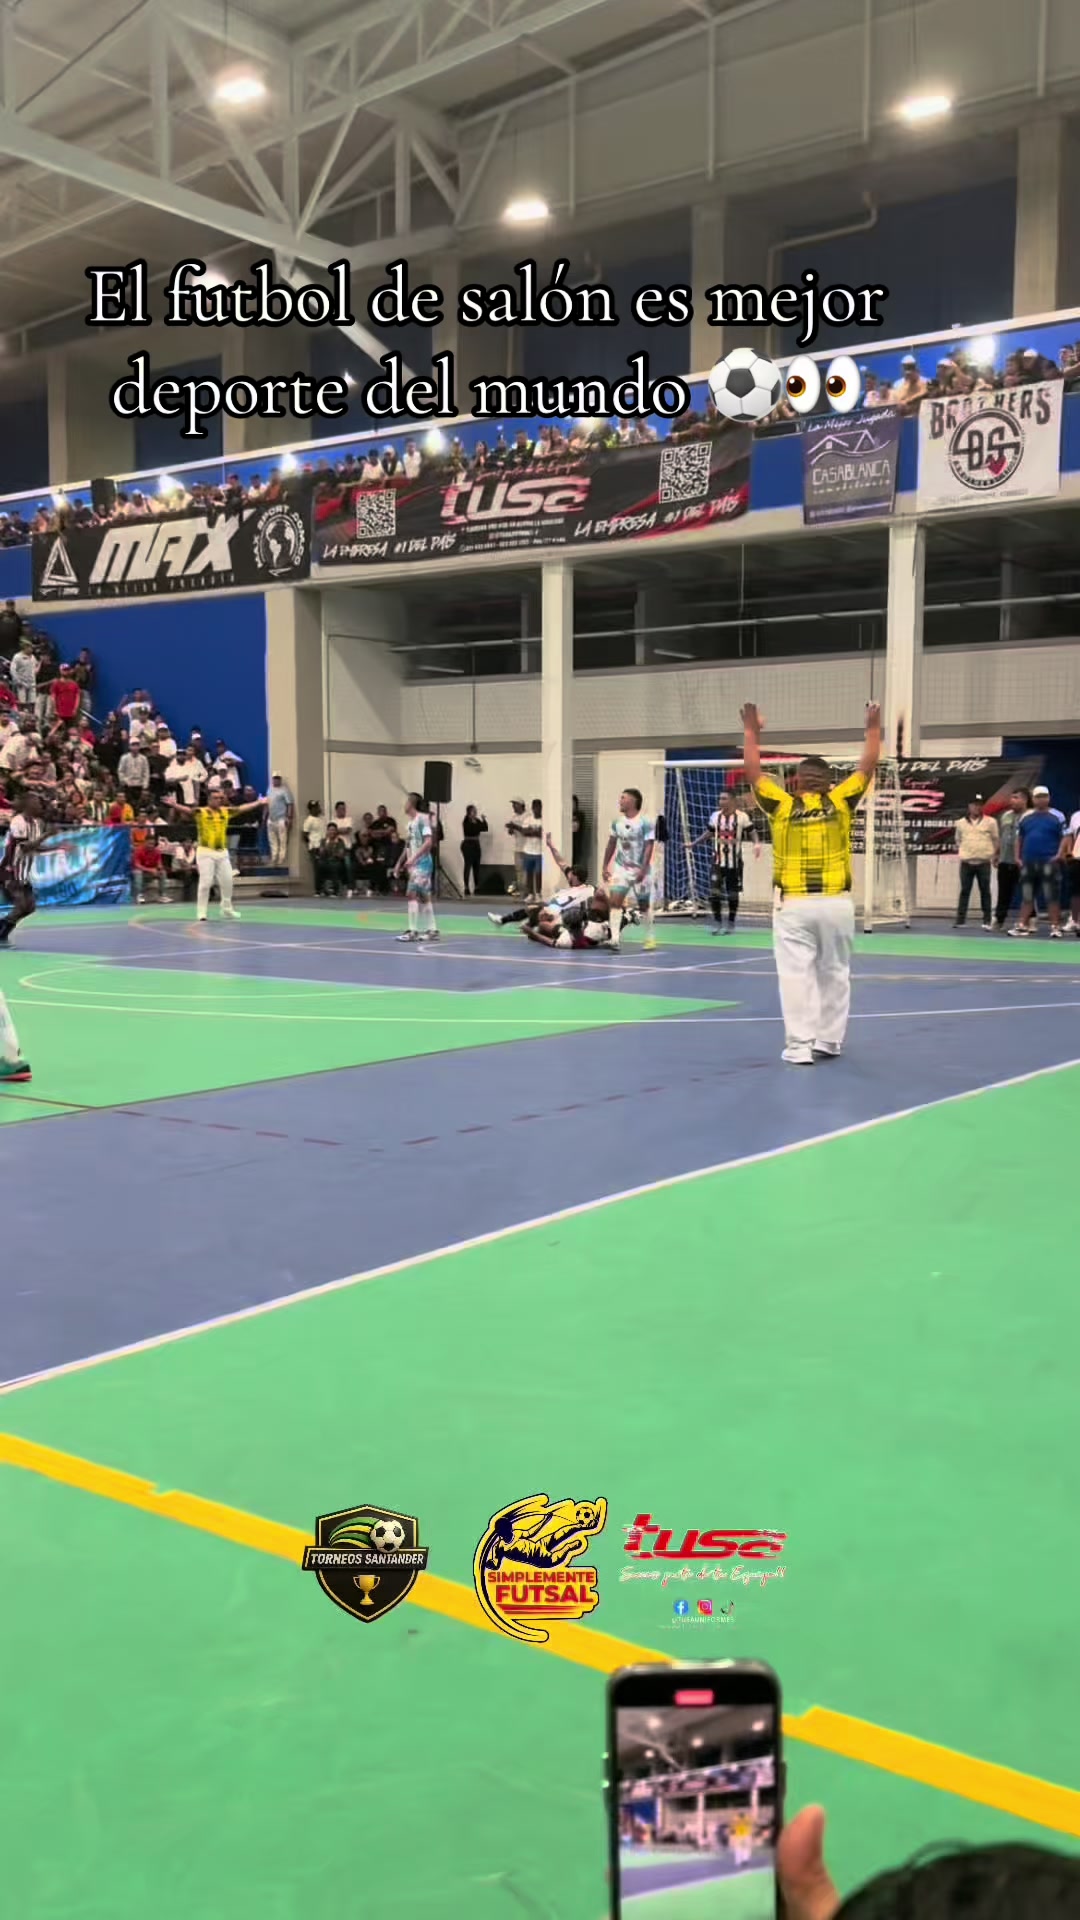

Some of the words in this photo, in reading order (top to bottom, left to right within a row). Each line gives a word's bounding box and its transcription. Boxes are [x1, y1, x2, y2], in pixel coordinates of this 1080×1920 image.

[812, 459, 891, 486] CASABLANCA
[574, 519, 592, 537] LA
[594, 513, 656, 536] EMPRESA
[682, 503, 704, 522] DEL
[88, 509, 256, 585] MAX
[322, 543, 338, 558] LA
[339, 541, 388, 557] EMPRESA
[407, 537, 428, 553] DEL
[910, 760, 941, 772] DEL
